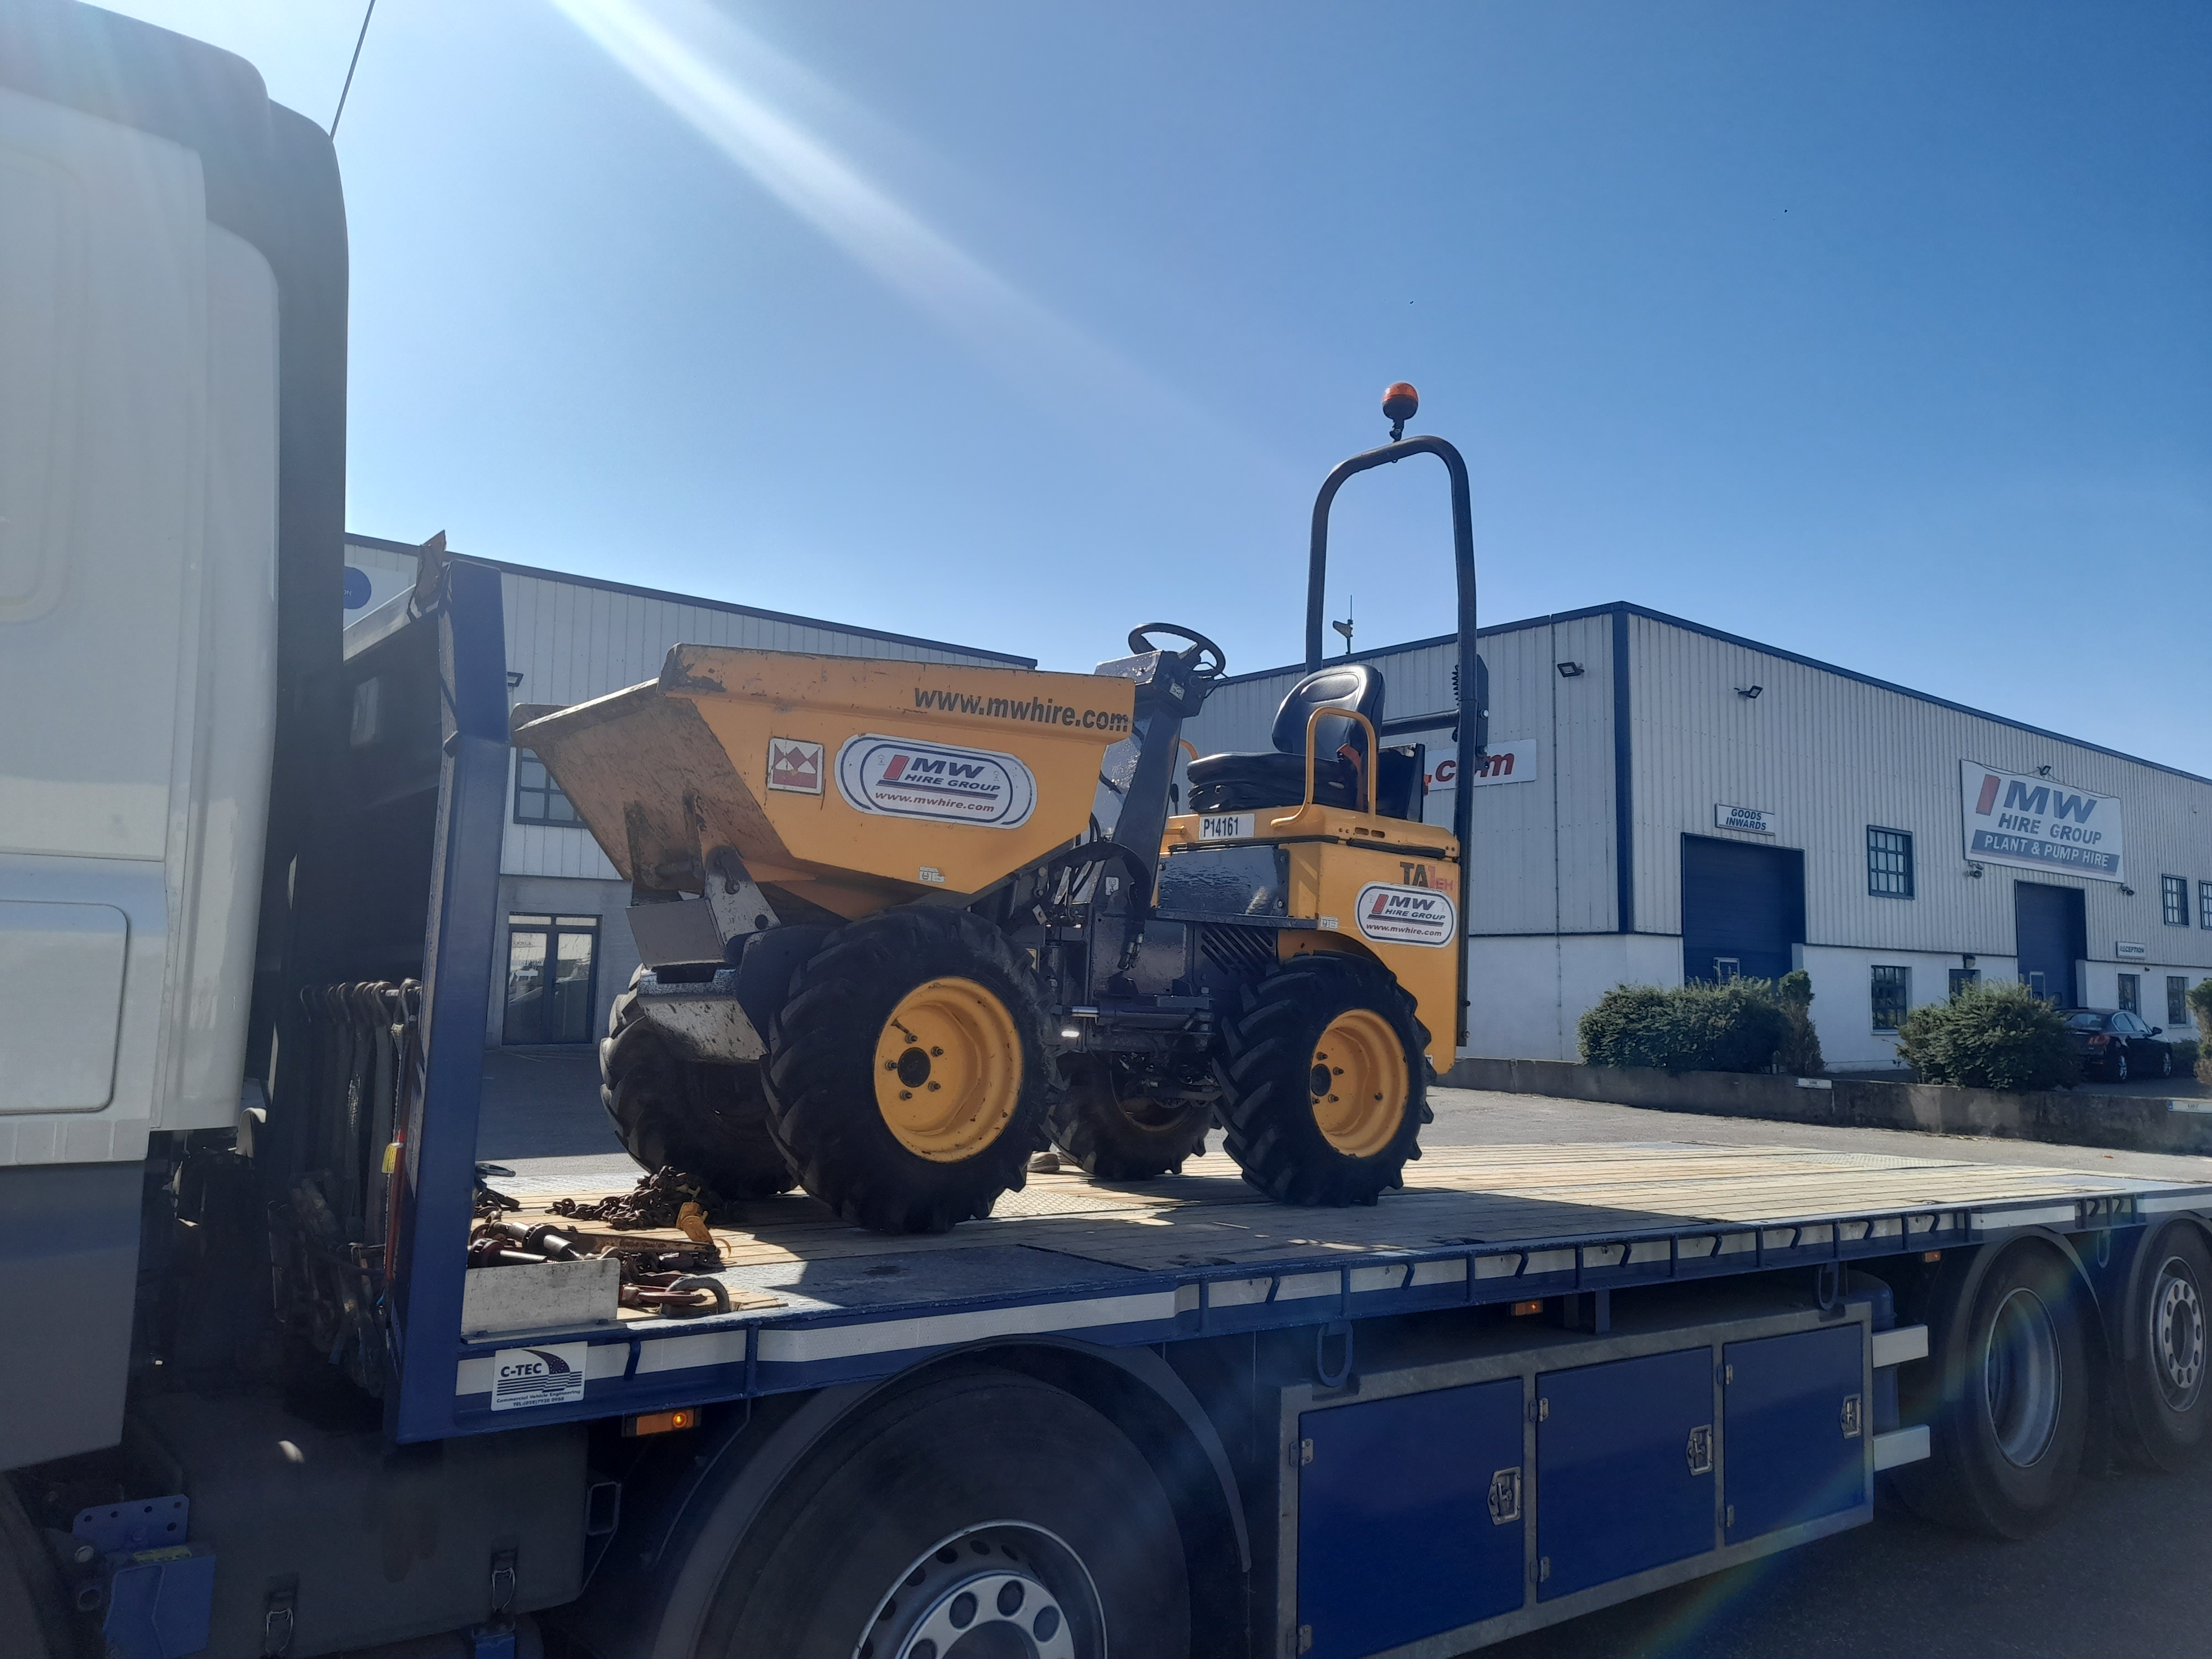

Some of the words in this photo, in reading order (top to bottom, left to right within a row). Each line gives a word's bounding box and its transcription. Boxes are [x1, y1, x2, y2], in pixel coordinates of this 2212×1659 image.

[914, 687, 1129, 732] www.mwhire.com
[910, 757, 987, 779] MW
[904, 774, 944, 785] HIRE
[947, 780, 1001, 792] GROUP
[875, 791, 995, 812] www.mwhire.com
[2003, 780, 2098, 824] MW
[1726, 817, 1766, 830] INWARDS
[1731, 808, 1762, 821] GOODS
[1203, 817, 1238, 837] P14161
[1998, 813, 2041, 834] HIRE
[2050, 824, 2102, 845] GROUP
[1984, 834, 2028, 853] PLANT
[2031, 842, 2040, 855] &
[2044, 844, 2079, 861] PUMP
[2082, 851, 2110, 867] HIRE
[1389, 895, 1436, 910] MW
[1411, 912, 1446, 920] GROUP
[1366, 924, 1442, 936] www.mwhire.com
[500, 1363, 542, 1377] C-TEC
